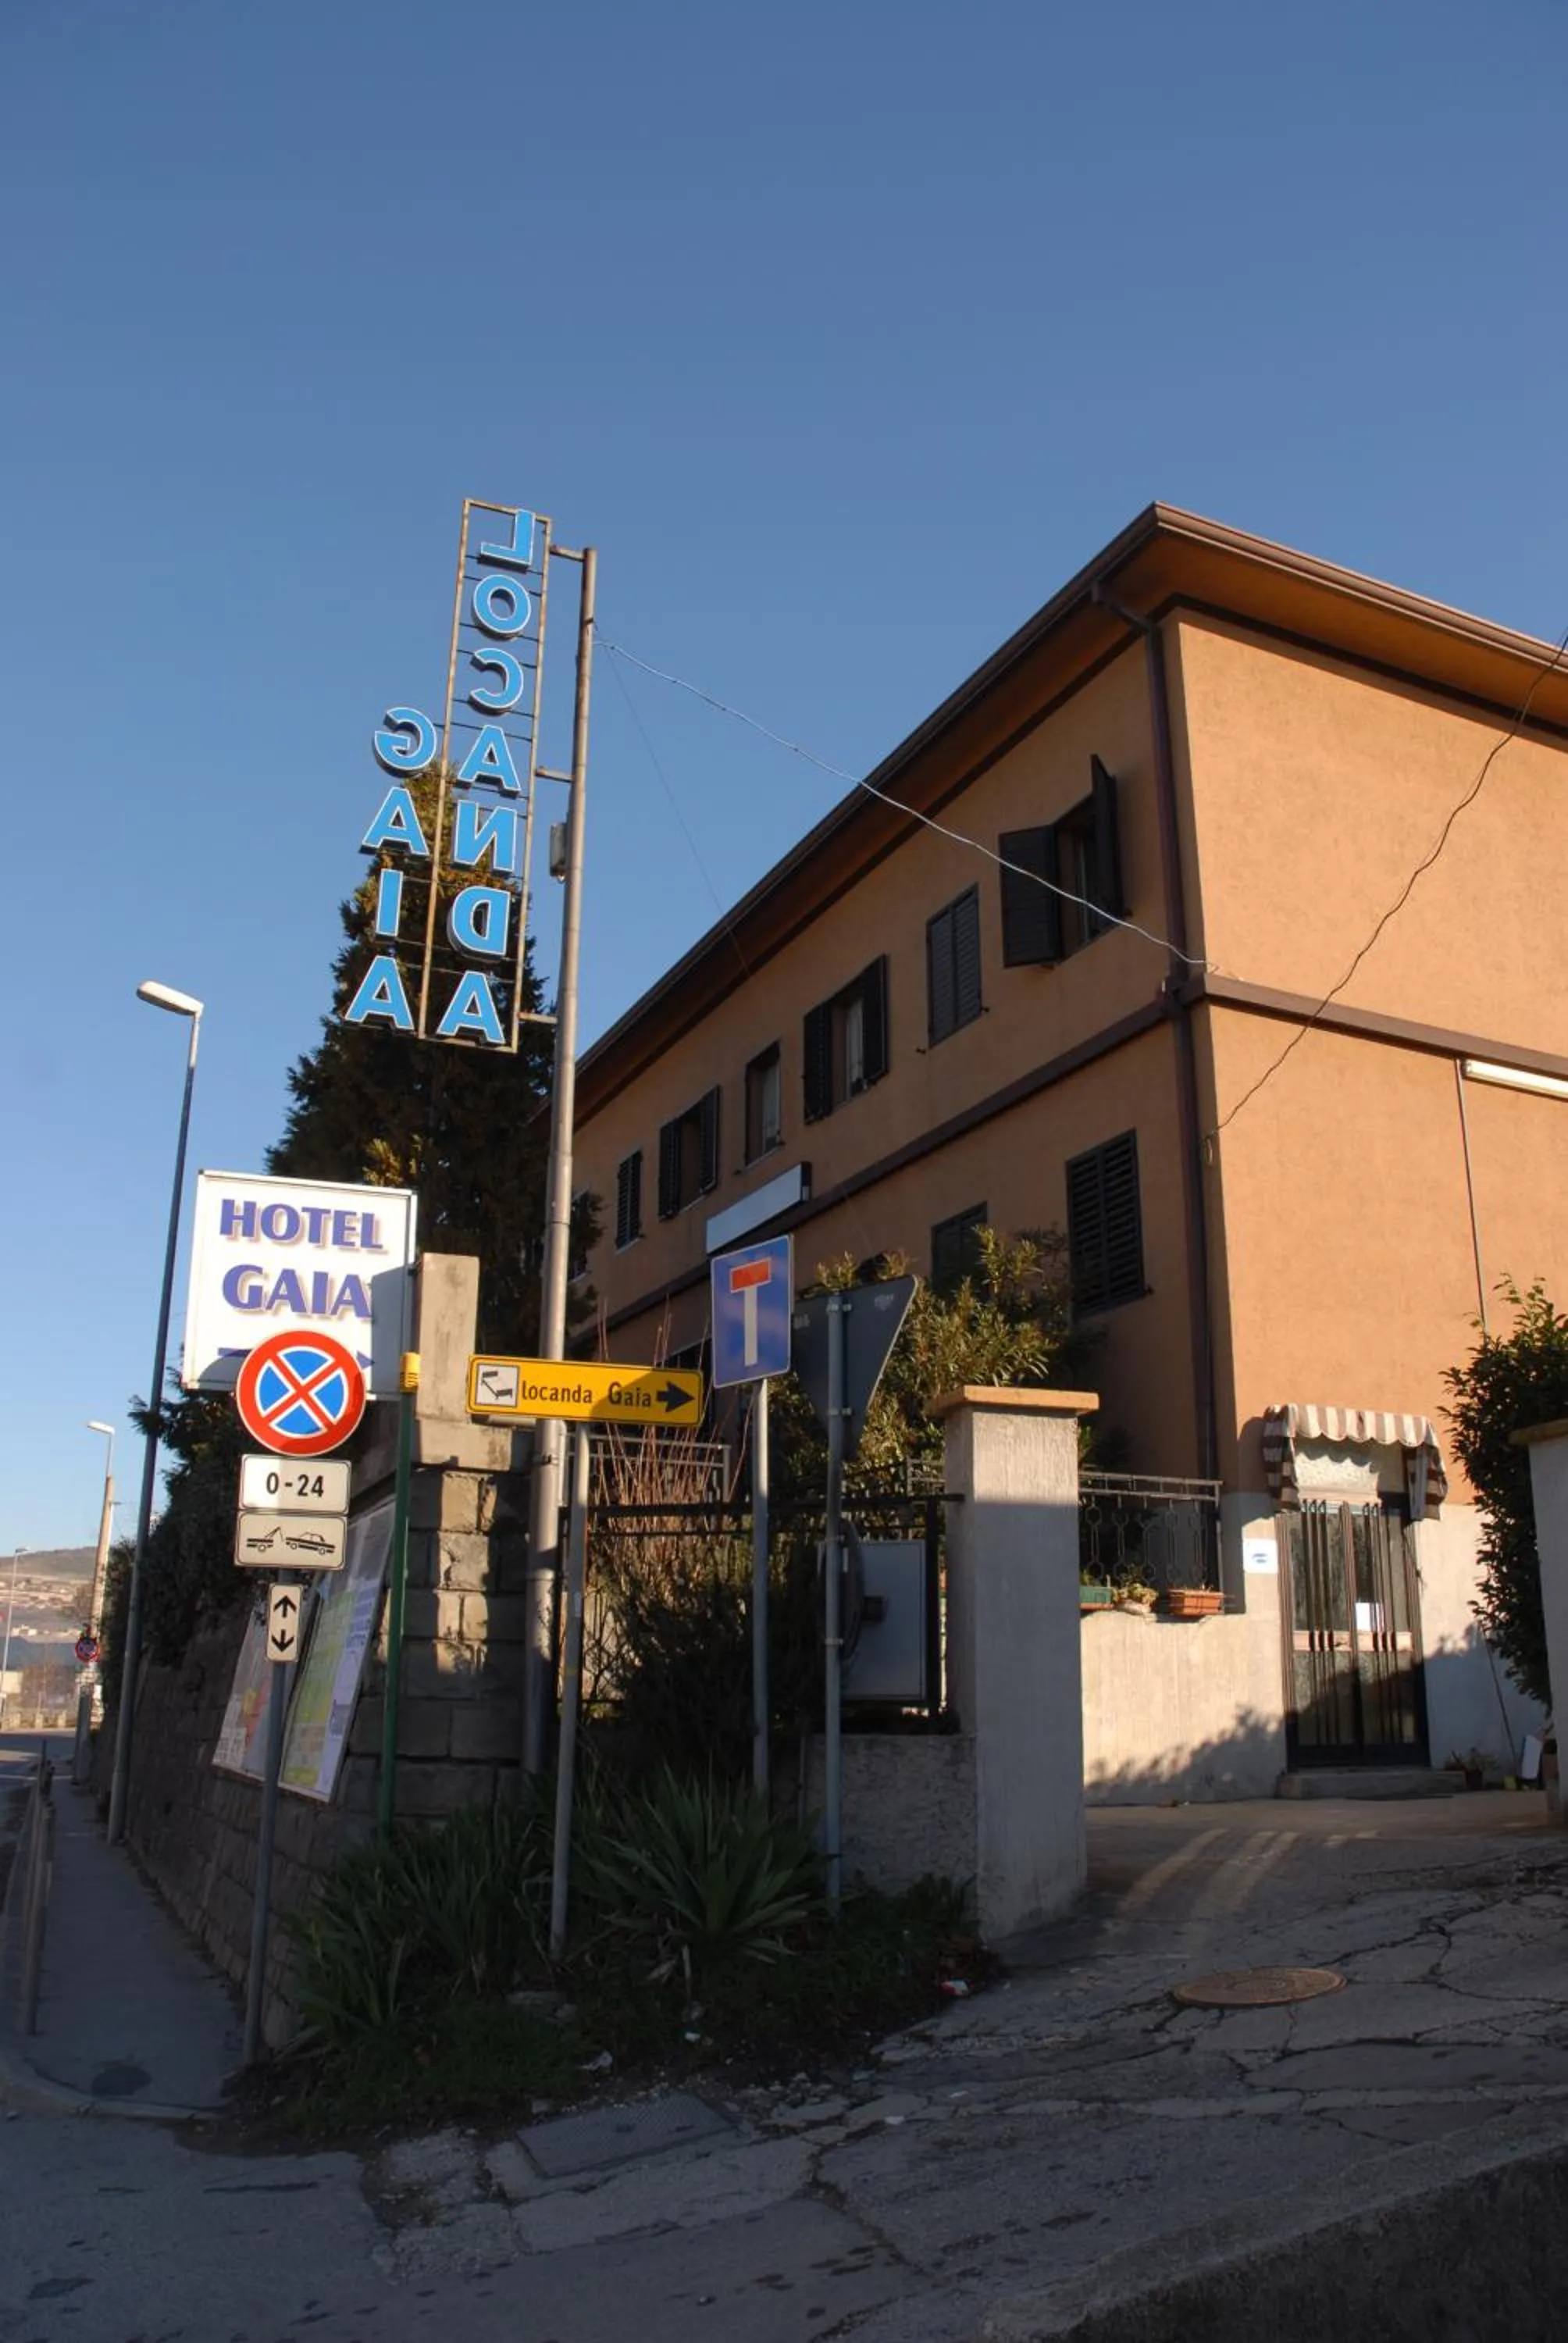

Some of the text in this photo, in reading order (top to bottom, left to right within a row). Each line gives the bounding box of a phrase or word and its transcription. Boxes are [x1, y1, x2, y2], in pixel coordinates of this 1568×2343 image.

[219, 1199, 383, 1250] HOTEL
[223, 1264, 373, 1318] GAIA
[522, 1381, 651, 1407] locanda Gaia
